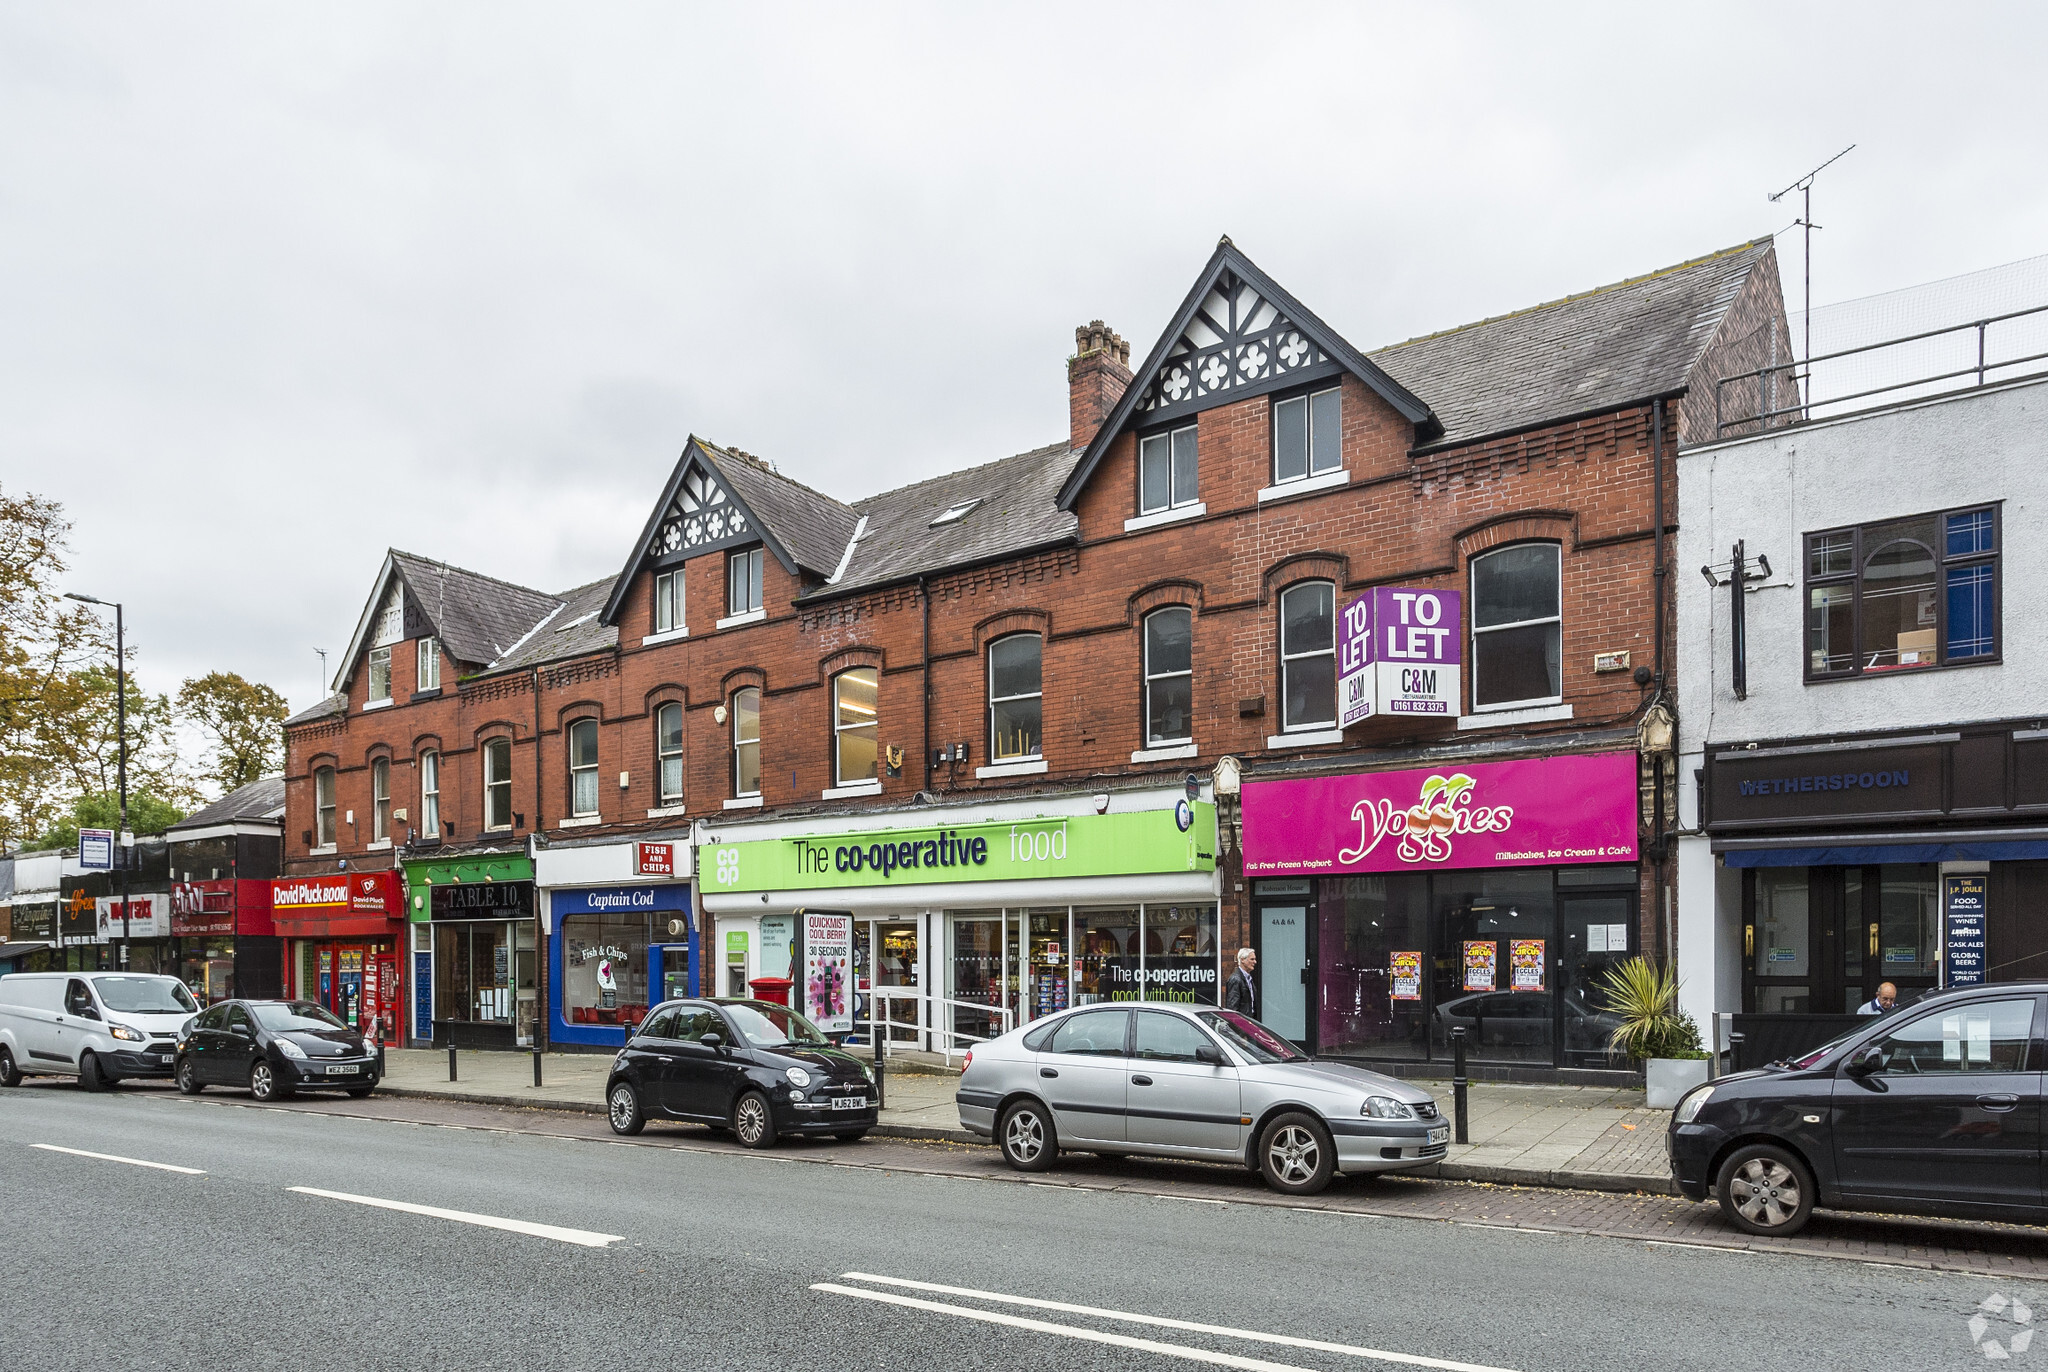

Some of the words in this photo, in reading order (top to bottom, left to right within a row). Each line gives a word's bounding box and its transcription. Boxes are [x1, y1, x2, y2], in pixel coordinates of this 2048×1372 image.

[1392, 592, 1442, 627] TO
[1344, 600, 1367, 639] TO
[1387, 625, 1450, 660] LET
[1342, 628, 1371, 674] LET
[1401, 668, 1437, 694] C&M
[1348, 673, 1365, 703] C&M
[1394, 701, 1411, 711] 0161
[1412, 702, 1426, 711] 832
[1427, 702, 1444, 712] 3375
[1738, 769, 1909, 796] WETHERSPOON
[645, 845, 667, 855] FISH
[793, 840, 829, 874] The
[835, 830, 988, 878] co-operative
[1008, 821, 1068, 862] food
[1547, 849, 1562, 858] Ice
[1564, 848, 1596, 857] Cream
[1598, 847, 1605, 855] &
[642, 863, 671, 872] CHIPS
[1277, 861, 1302, 869] Frozen
[1302, 860, 1332, 869] Yoghurt
[274, 884, 299, 905] David
[299, 882, 323, 904] Pluck
[1287, 884, 1304, 892] House
[1950, 886, 1960, 894] J.P.
[1962, 886, 1983, 894] JOULE
[370, 896, 384, 904] Pluck
[587, 891, 630, 911] Captain
[632, 889, 655, 906] Cod
[809, 916, 847, 929] QUICKMIST
[1272, 918, 1280, 926] 4A
[1280, 918, 1286, 926] &
[1286, 918, 1295, 926] 6A
[809, 928, 826, 940] COOL
[826, 930, 847, 940] BERRY
[582, 948, 598, 961] Fish
[598, 946, 605, 956] &
[606, 946, 628, 962] Chips
[808, 946, 818, 956] 30
[818, 946, 847, 957] SECONDS
[1111, 965, 1132, 983] The
[348, 984, 354, 994] P
[1168, 986, 1195, 1004] food
[834, 1098, 851, 1109] MJ62
